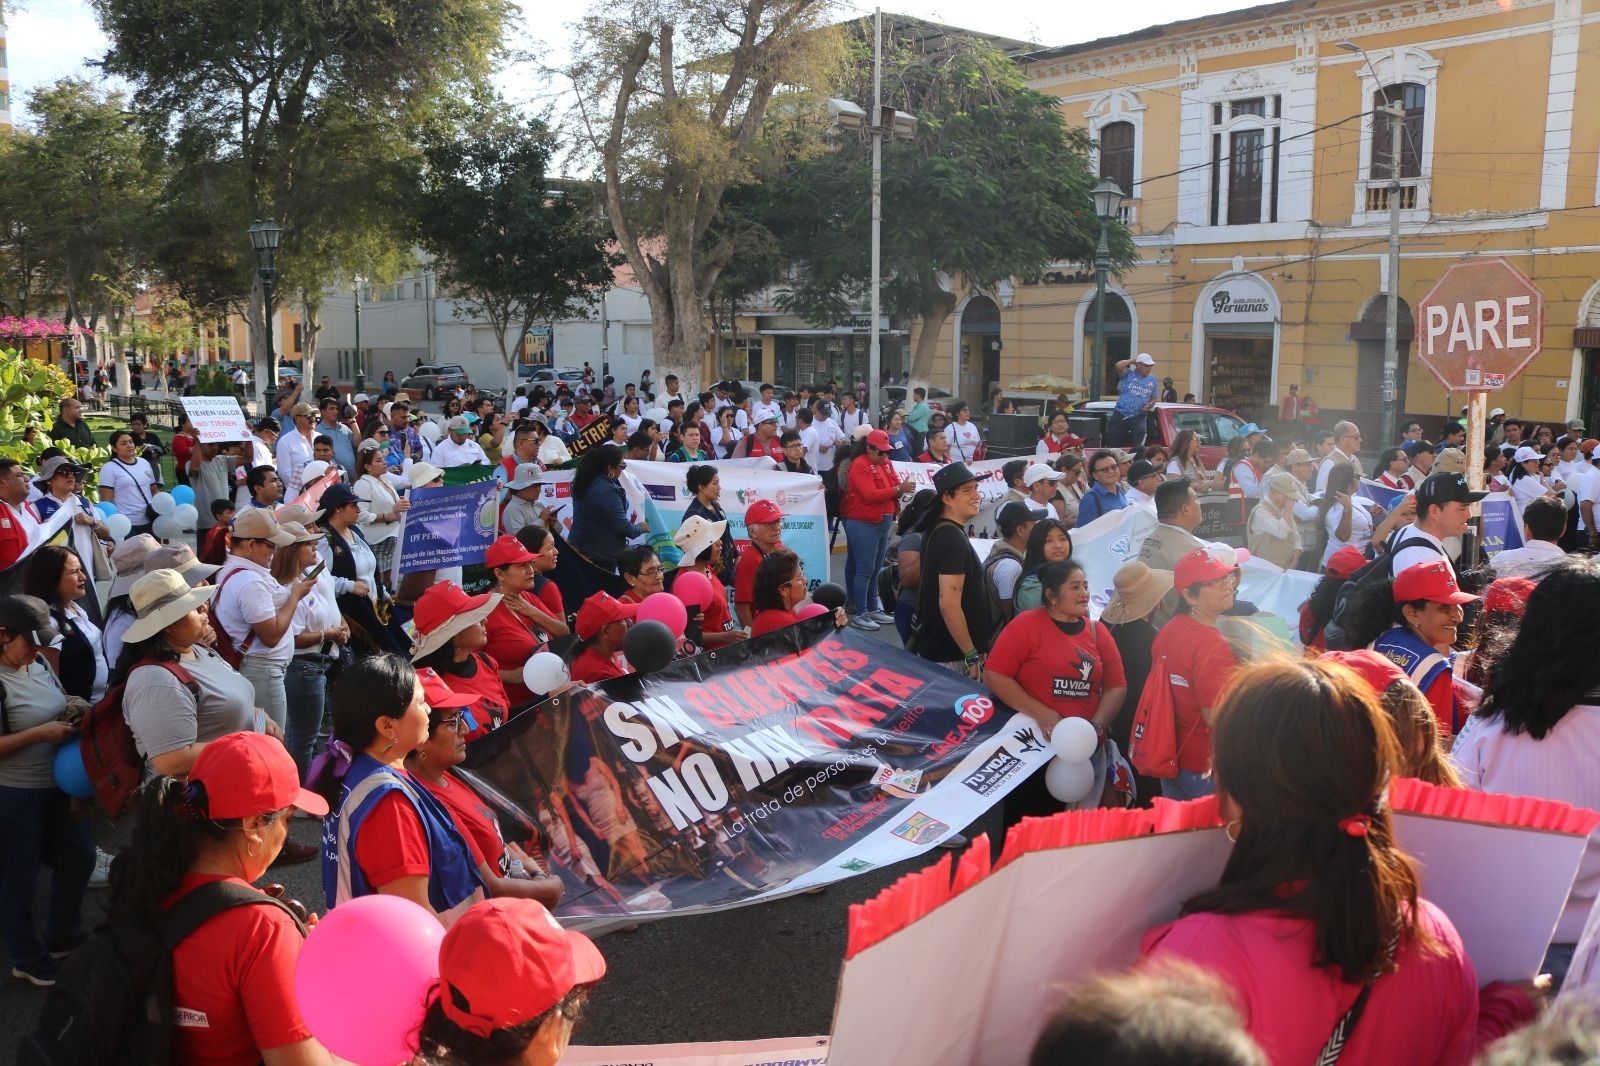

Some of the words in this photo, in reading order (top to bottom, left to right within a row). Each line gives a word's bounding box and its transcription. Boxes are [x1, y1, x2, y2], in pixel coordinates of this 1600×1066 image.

[1212, 293, 1269, 314] Peruanas
[1426, 295, 1532, 355] PARE
[199, 431, 226, 439] PRECIO
[603, 695, 706, 763] SIN
[684, 640, 869, 729] CLIENTES
[1053, 678, 1069, 689] TU
[1069, 679, 1091, 690] VIDA
[961, 697, 993, 724] 100
[647, 752, 729, 831] NO
[721, 725, 815, 792] HAY
[789, 667, 925, 749] TRATA
[721, 820, 746, 839] La
[744, 797, 782, 825] trata
[783, 783, 805, 804] de
[861, 743, 877, 757] es
[892, 704, 926, 736] delito
[964, 773, 987, 787] TU
[982, 752, 1012, 774] VIDA
[977, 784, 988, 793] NO
[986, 770, 1002, 785] TIENE
[1001, 759, 1018, 774] PRECIO
[983, 779, 1006, 798] DENUNCIA
[1004, 773, 1013, 783] LA
[1011, 760, 1028, 775] TRATA
